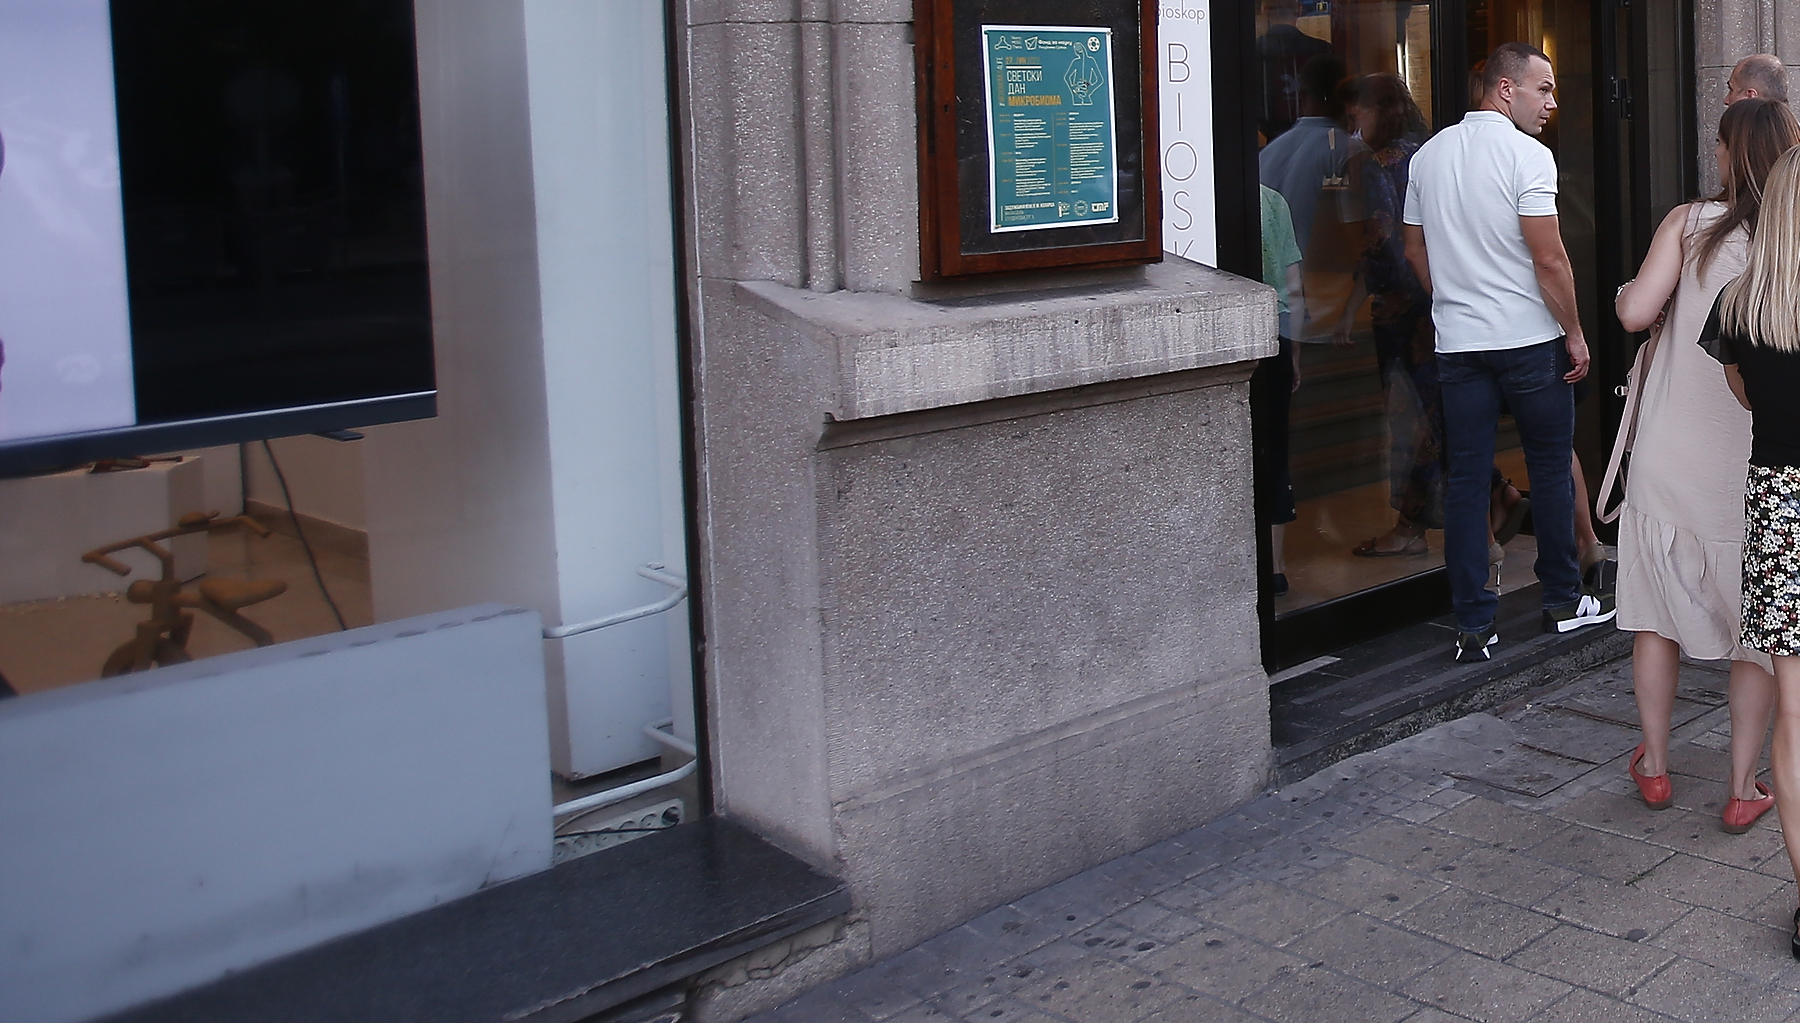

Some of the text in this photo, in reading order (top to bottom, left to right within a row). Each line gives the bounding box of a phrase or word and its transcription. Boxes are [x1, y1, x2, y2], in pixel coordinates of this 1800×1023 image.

[1006, 70, 1043, 82] СВЕТСКИ
[1008, 83, 1026, 95] ДАН
[1008, 95, 1062, 106] МИКРОБИОМА
[1575, 595, 1601, 618] N
